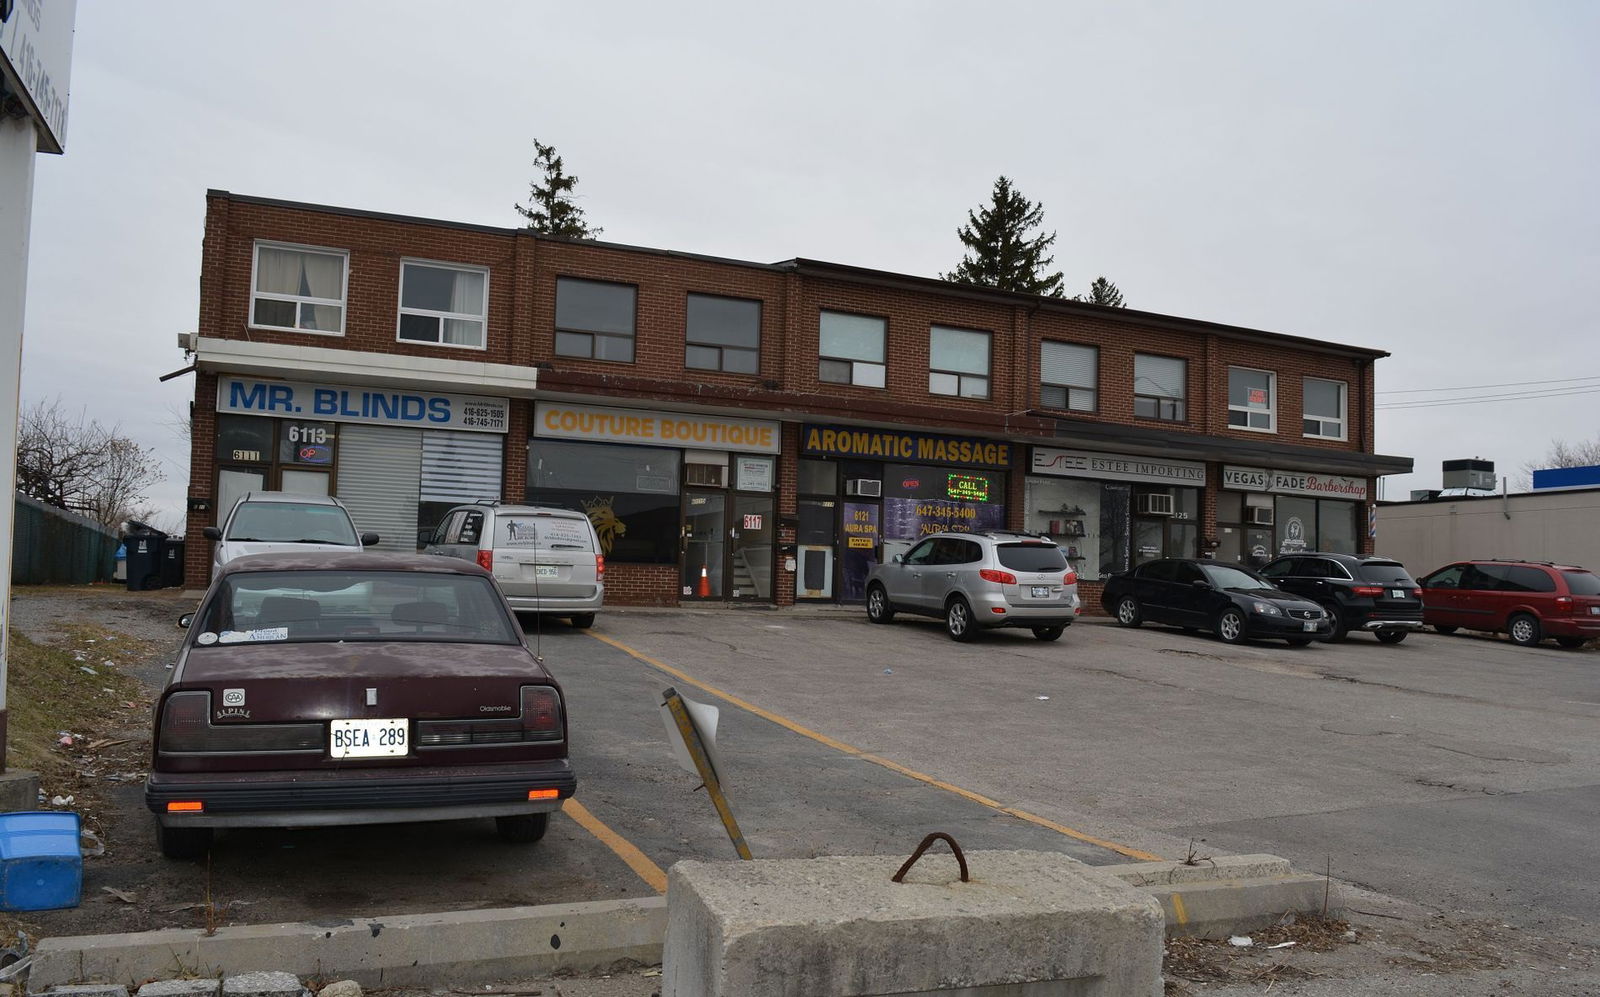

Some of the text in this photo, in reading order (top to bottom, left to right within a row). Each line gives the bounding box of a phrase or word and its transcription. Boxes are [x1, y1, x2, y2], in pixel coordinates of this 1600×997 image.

[230, 381, 451, 423] MR. BLINDS
[288, 426, 327, 444] 6113
[544, 410, 773, 447] COUTURE BOUTIQUE
[233, 451, 259, 460] 6111
[807, 428, 1009, 466] AROMATIC MASSAGE
[1092, 460, 1129, 472] ESTEE
[1136, 464, 1204, 479] IMPORTING
[959, 481, 977, 490] CALL
[1225, 471, 1366, 496] VEGAS FADE Barbershop
[854, 511, 869, 521] 6121
[916, 504, 977, 518] 647-345-5400
[743, 515, 762, 529] 6117
[845, 523, 877, 533] AURA SPA
[335, 727, 405, 748] BSEA 289
